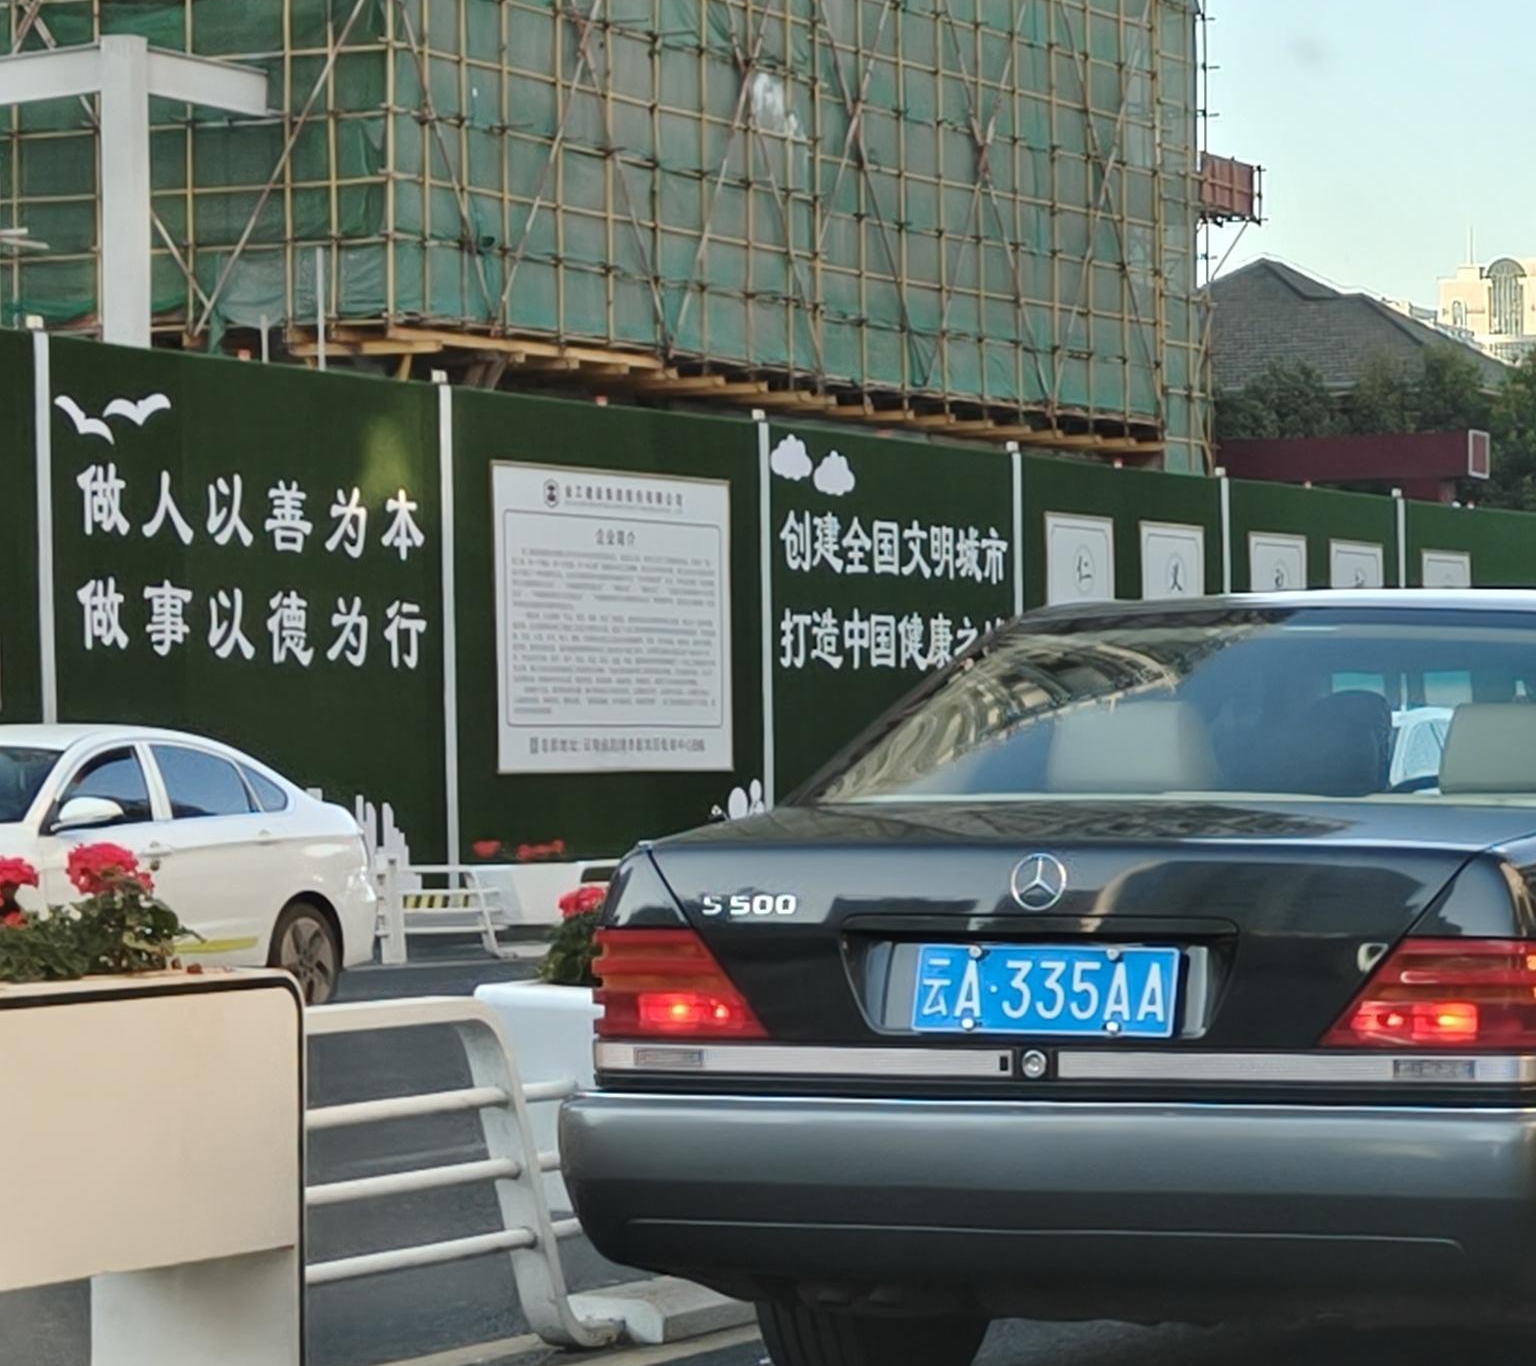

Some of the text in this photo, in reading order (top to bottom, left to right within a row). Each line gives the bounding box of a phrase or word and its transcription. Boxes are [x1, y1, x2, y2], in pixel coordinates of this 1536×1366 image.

[76, 463, 425, 561] 做人以善为本
[779, 509, 1009, 585] 创建全国文明城市
[76, 576, 427, 669] 做事以德为行
[779, 608, 1005, 671] 打造中国健康之
[702, 894, 796, 915] S 500
[922, 957, 1165, 1023] 云A·335AA
